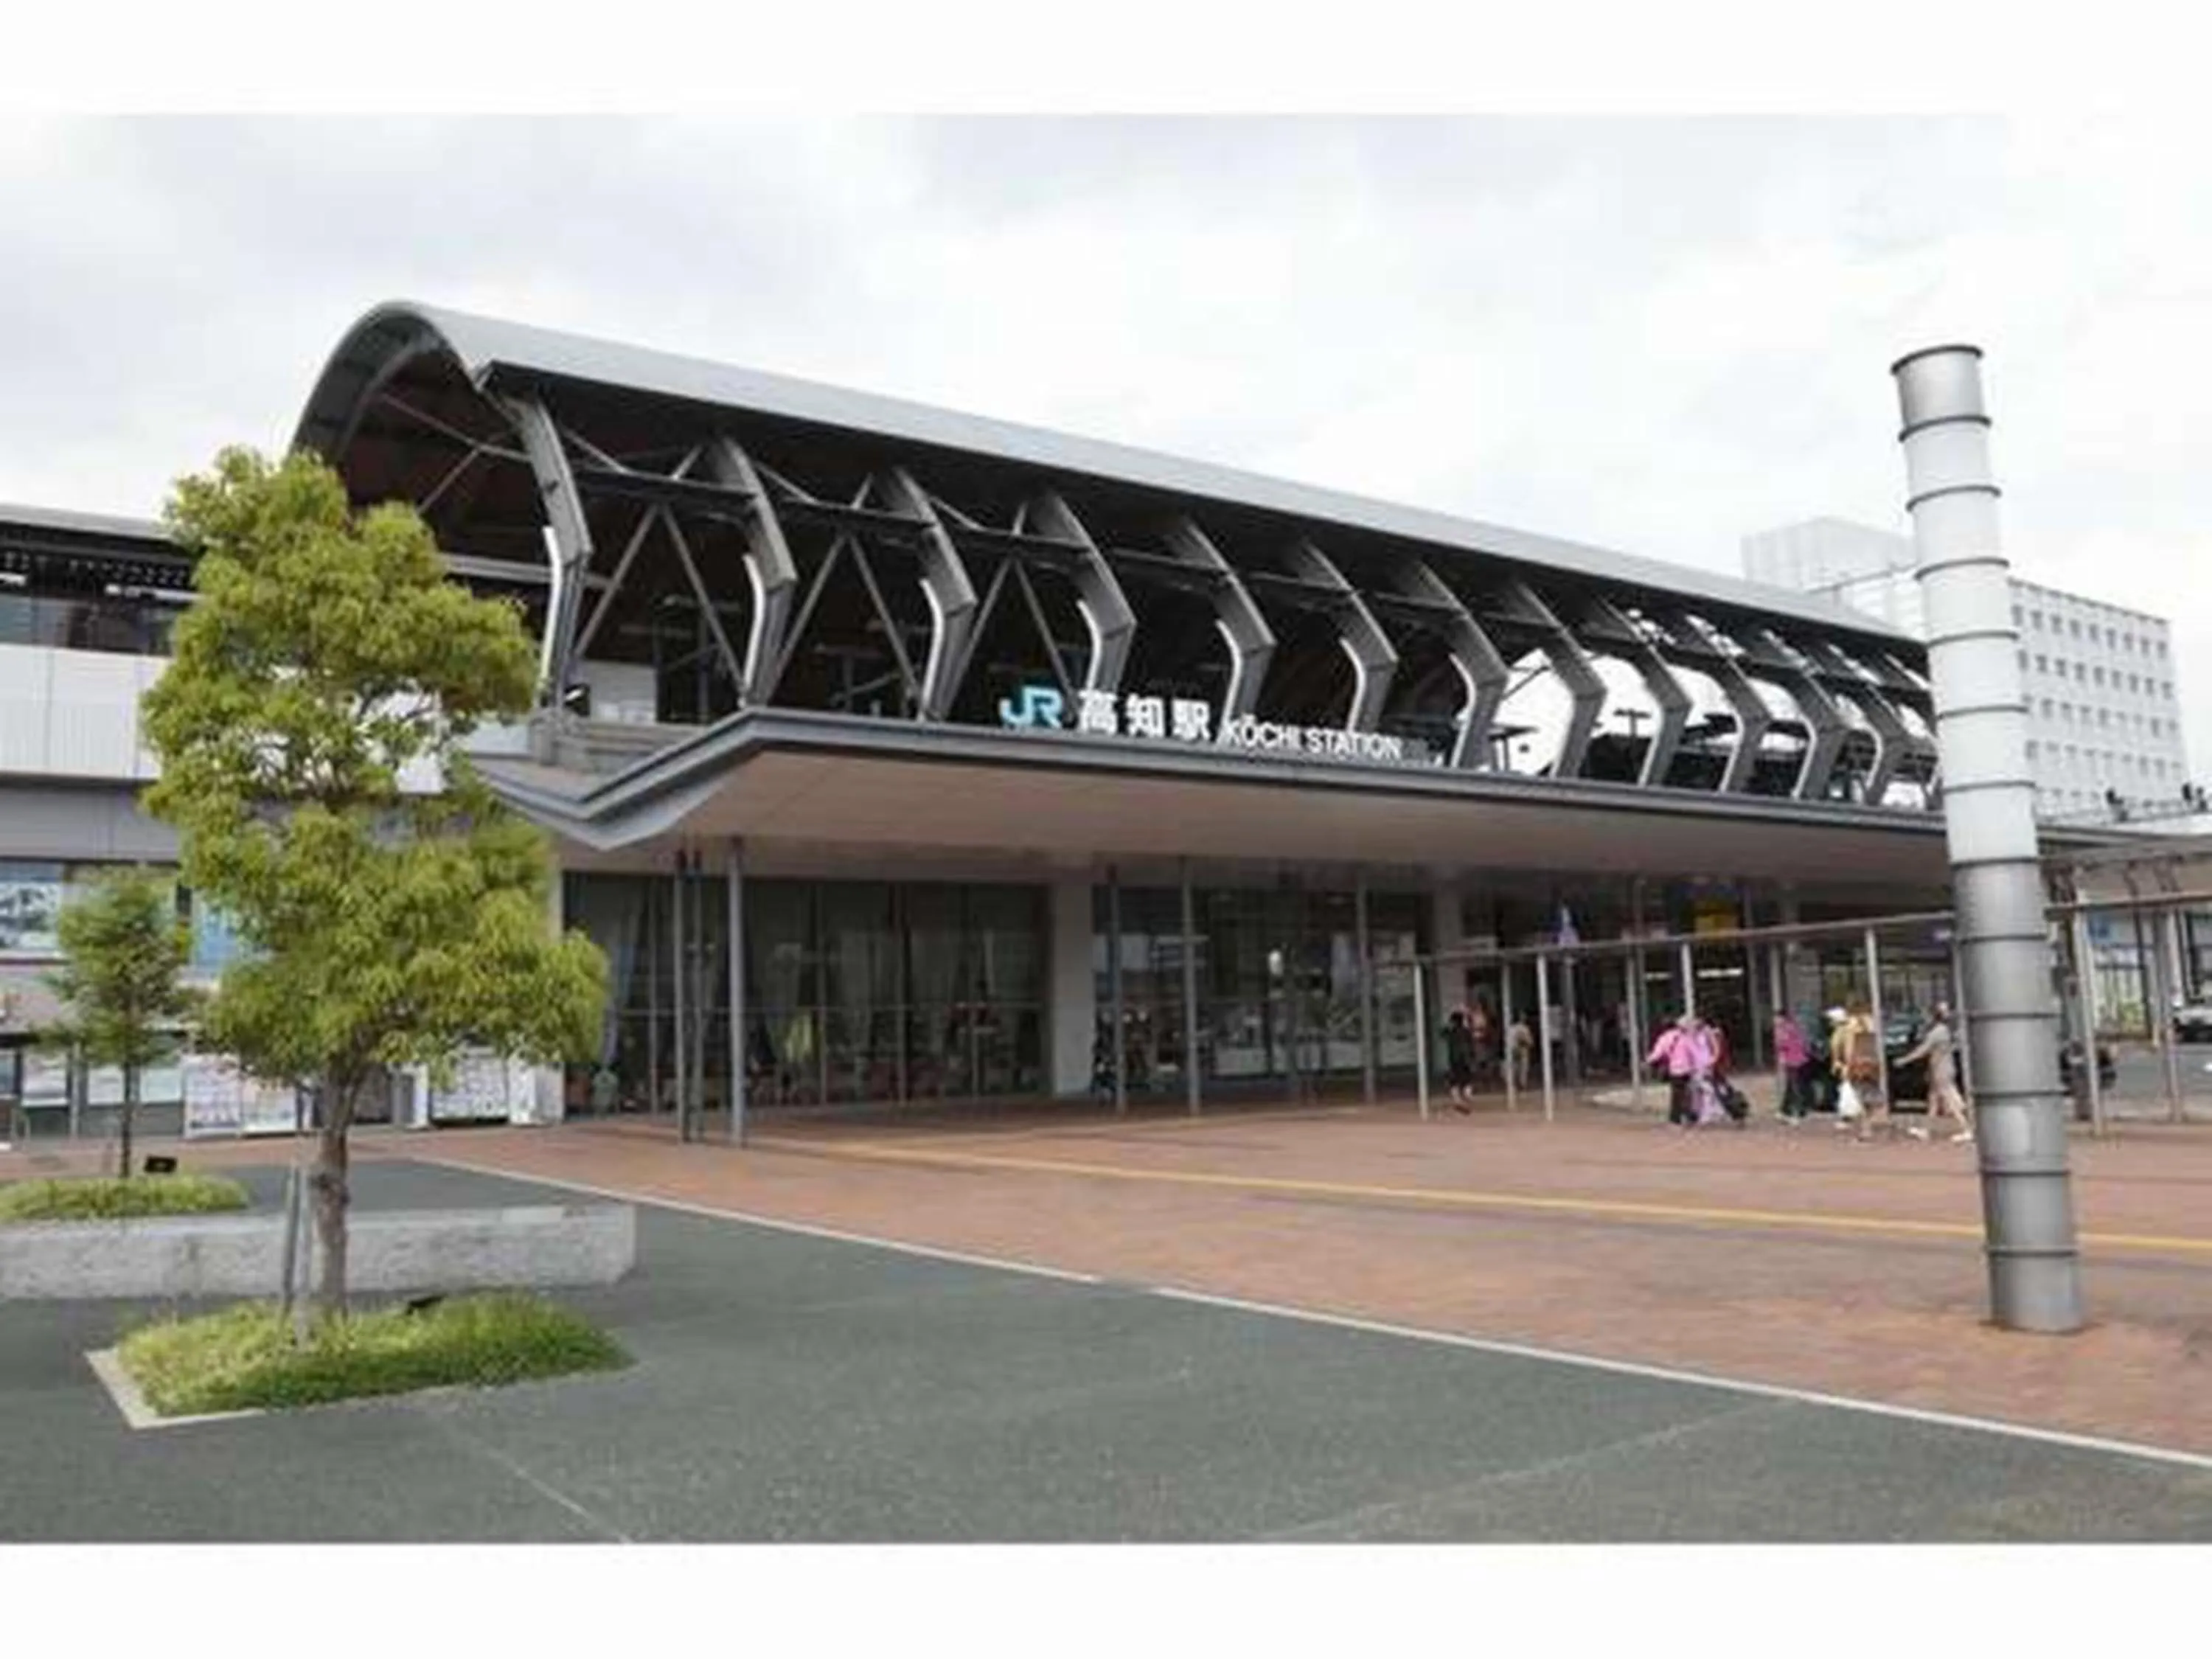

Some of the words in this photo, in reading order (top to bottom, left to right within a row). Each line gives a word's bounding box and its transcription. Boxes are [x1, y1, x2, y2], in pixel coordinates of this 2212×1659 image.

[999, 685, 1063, 728] JR
[1077, 688, 1211, 740] 高知駅
[1304, 726, 1402, 760] STATION
